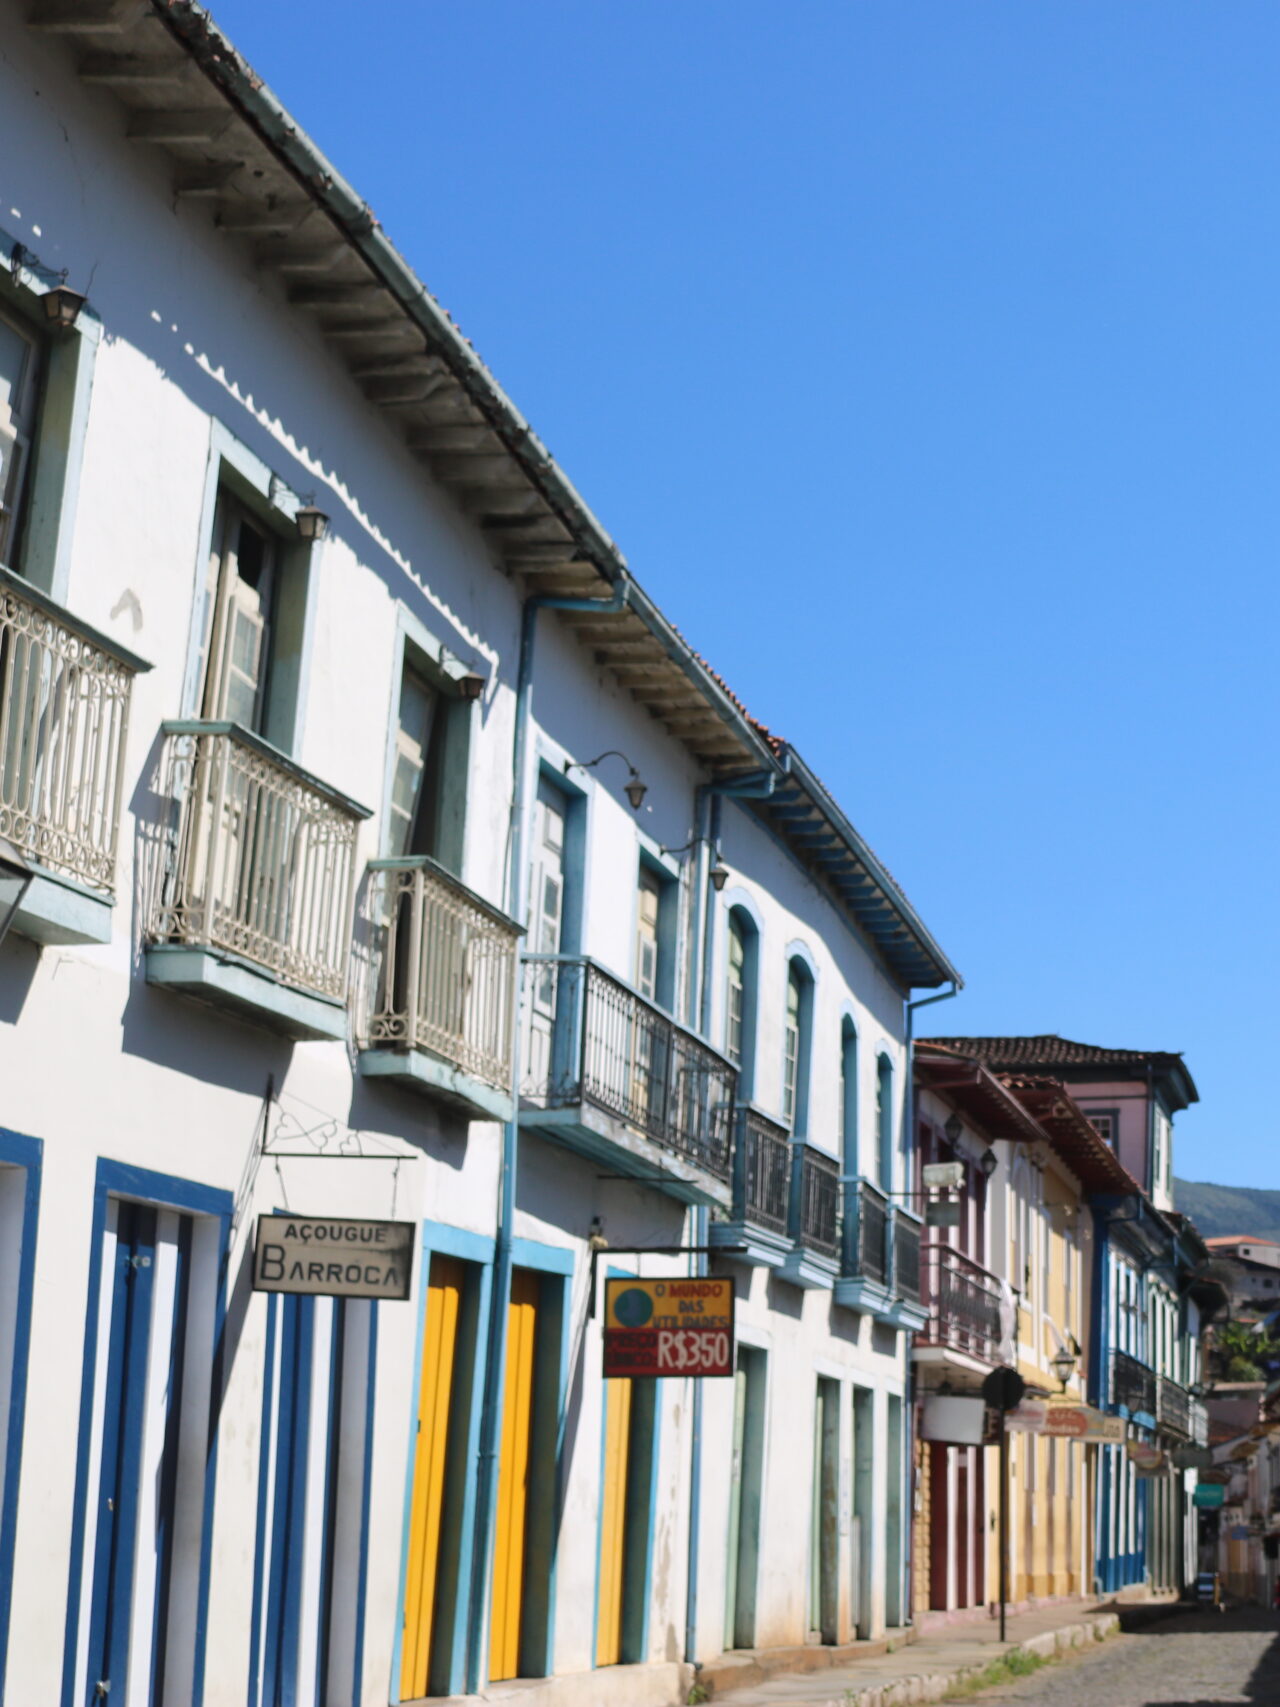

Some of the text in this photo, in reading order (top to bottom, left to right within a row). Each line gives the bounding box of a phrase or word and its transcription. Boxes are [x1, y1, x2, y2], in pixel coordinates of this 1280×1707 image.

[284, 1223, 389, 1244] AÇOUGUE
[259, 1243, 398, 1286] BARROCA
[655, 1284, 723, 1298] O MUNDO
[679, 1299, 705, 1314] DAS
